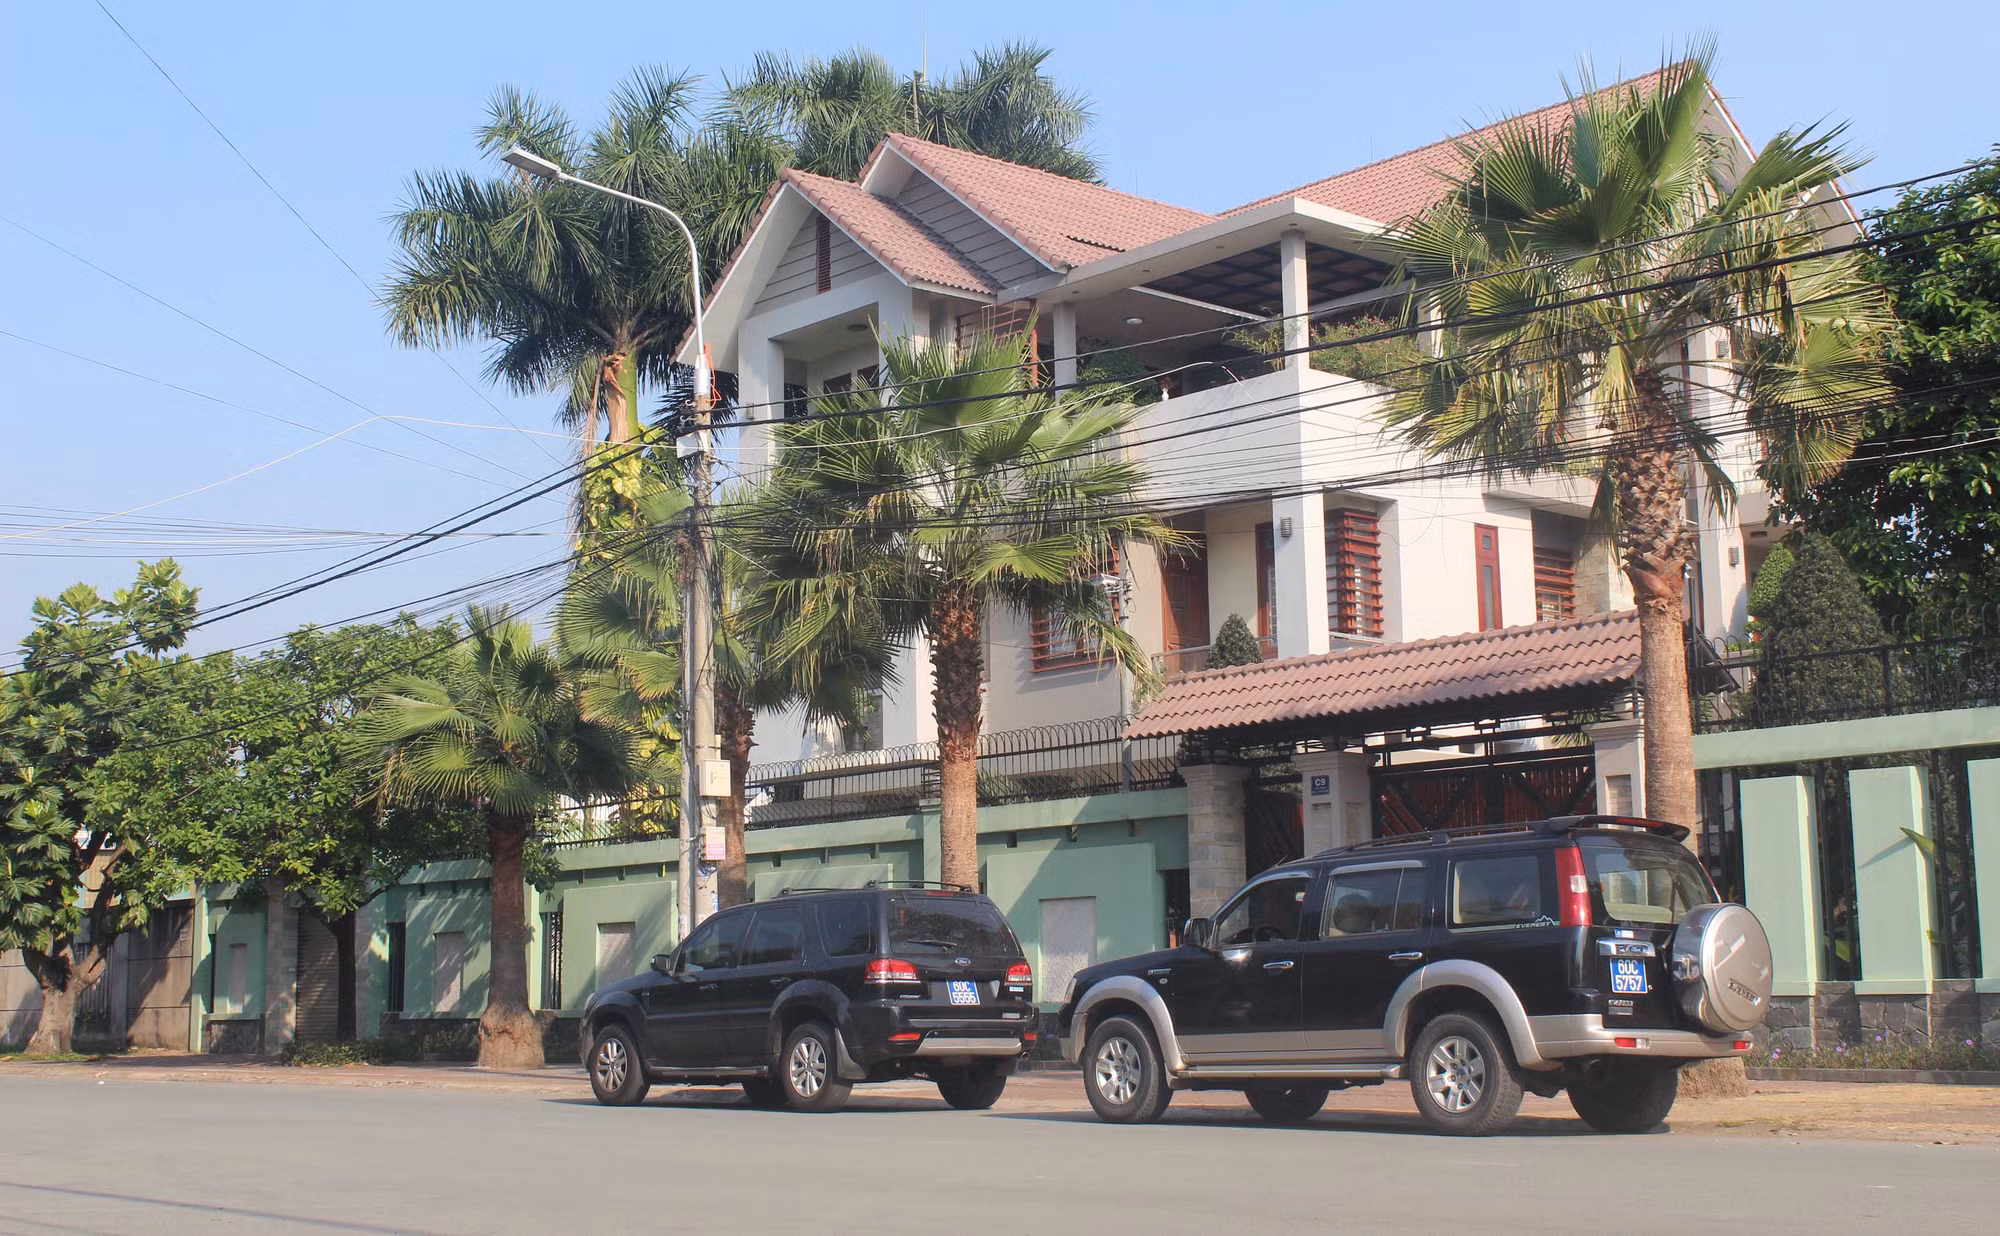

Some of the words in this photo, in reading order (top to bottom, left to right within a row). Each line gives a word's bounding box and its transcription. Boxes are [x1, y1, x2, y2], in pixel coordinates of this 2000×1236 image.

[1515, 921, 1551, 929] EVEREST
[1618, 959, 1638, 974] 60C
[953, 981, 971, 992] 60C
[1615, 974, 1642, 991] 5757
[952, 992, 976, 1003] 5555
